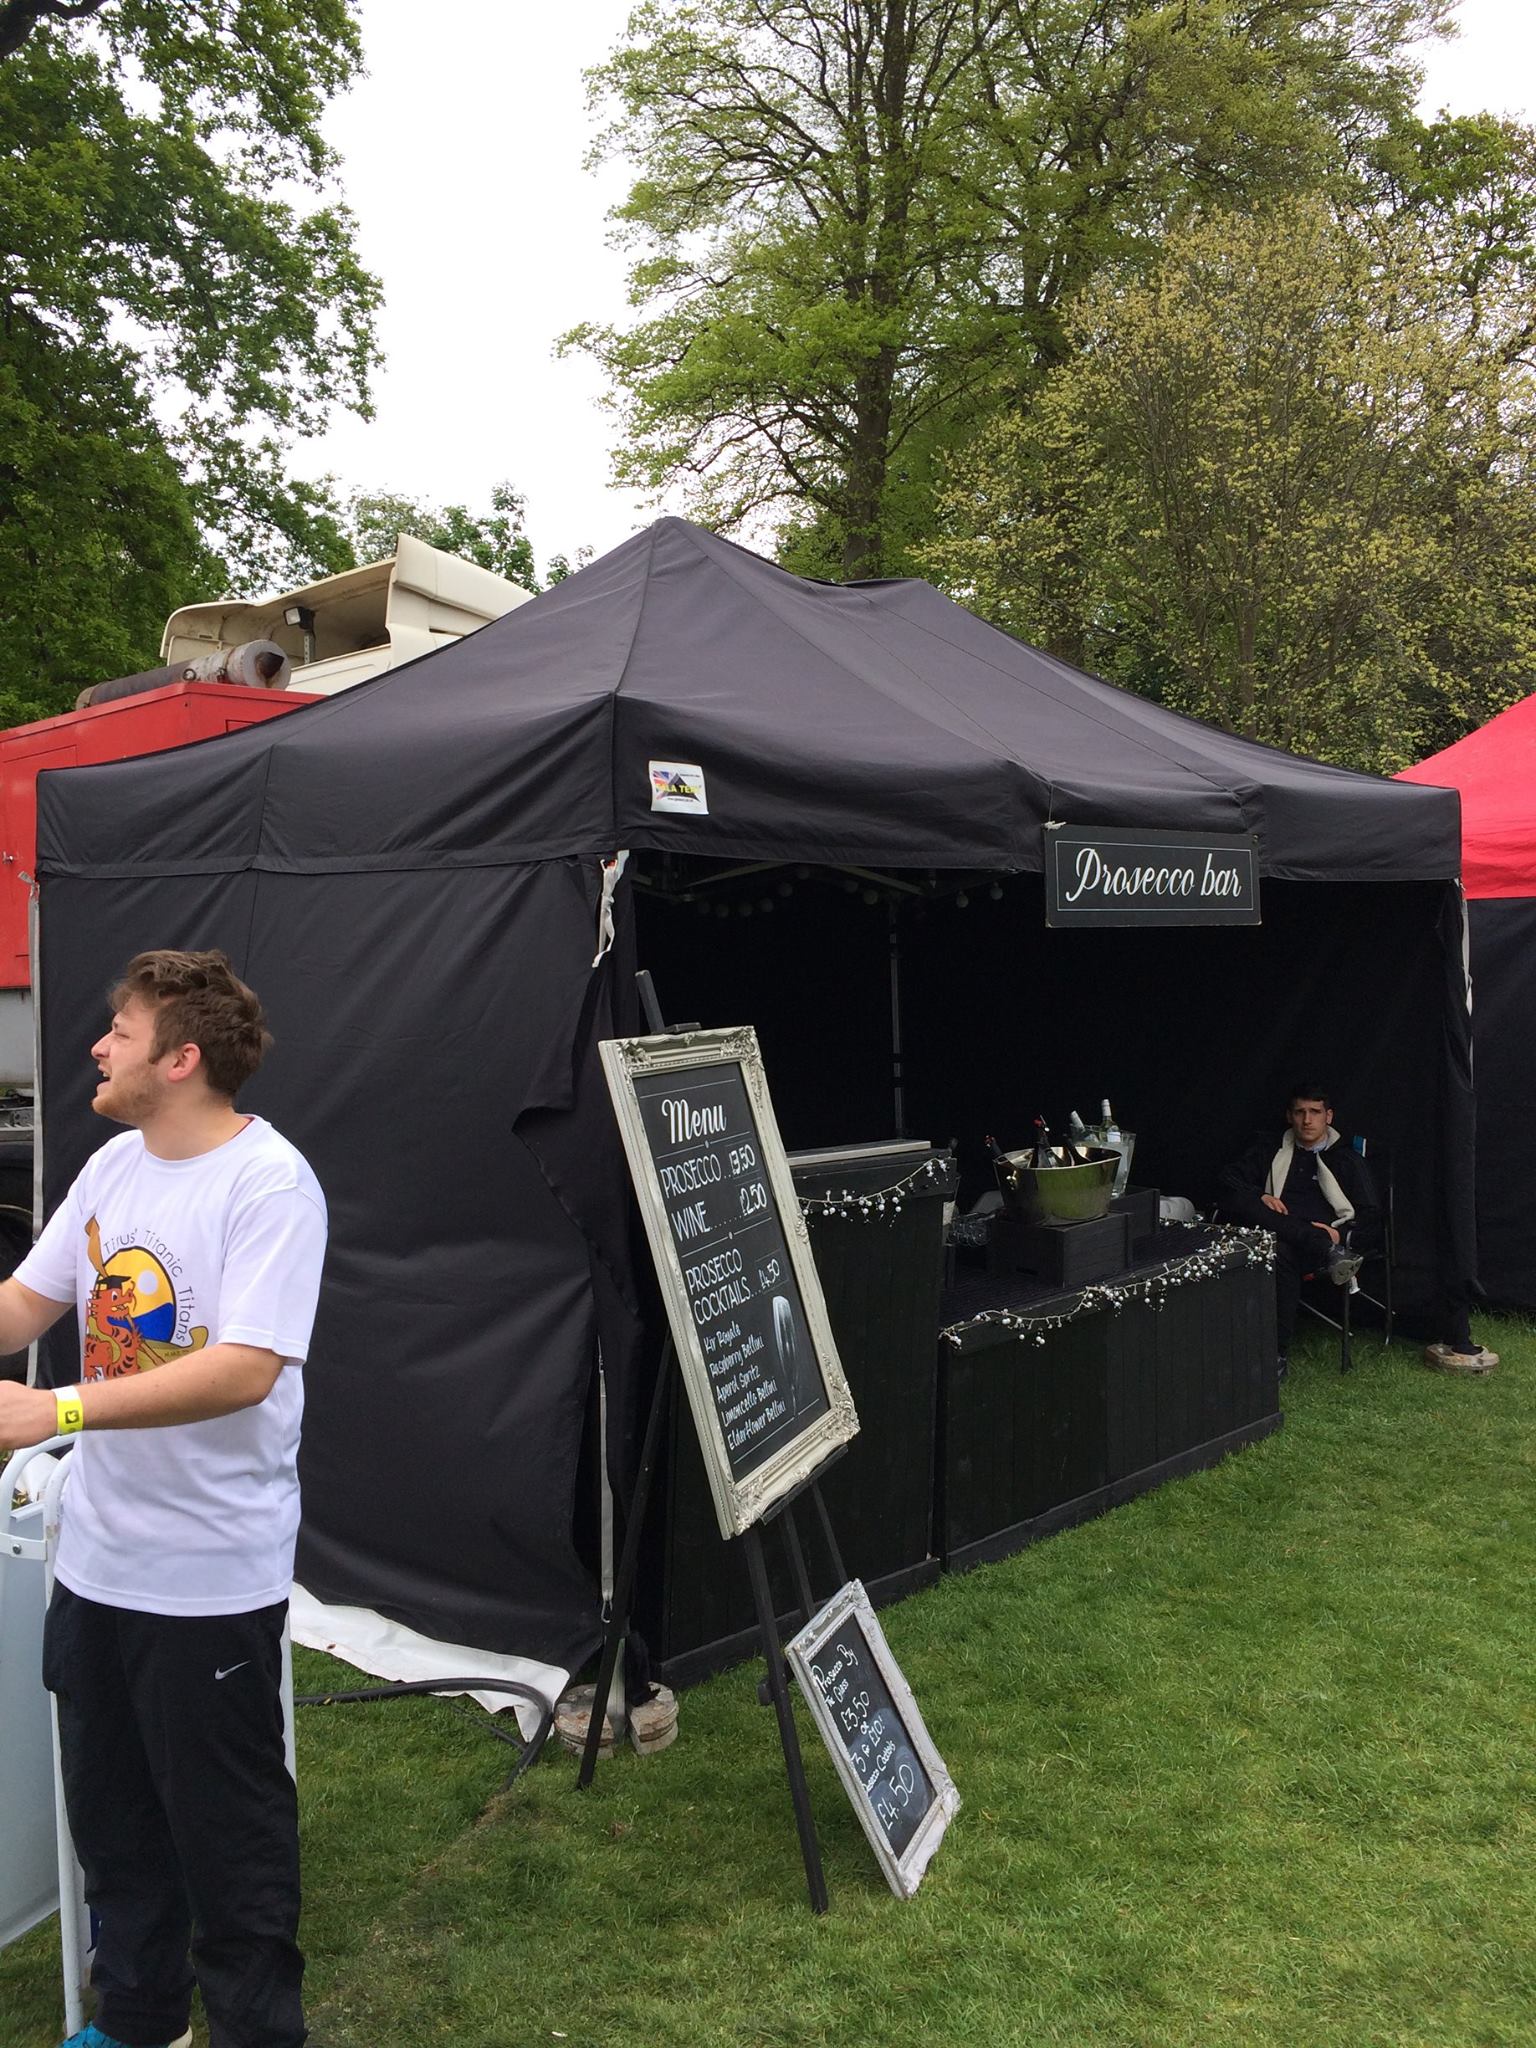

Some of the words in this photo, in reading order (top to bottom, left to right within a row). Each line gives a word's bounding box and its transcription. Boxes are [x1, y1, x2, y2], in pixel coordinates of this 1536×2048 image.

[1065, 848, 1195, 902] Prosecco
[1200, 852, 1242, 897] bar
[661, 1099, 727, 1144] Menu
[660, 1153, 722, 1199] PROSECCO
[671, 1201, 711, 1242] WINE
[143, 1229, 183, 1278] Titanic
[176, 1286, 196, 1342] Titans
[685, 1248, 743, 1295] PROSECCO
[694, 1276, 751, 1325] COCKTAILS
[703, 1336, 717, 1355] Kir
[716, 1374, 740, 1404] Aperol
[836, 1644, 859, 1667] By
[840, 1691, 870, 1732] £3.50
[851, 1752, 866, 1773] 3
[877, 1764, 914, 1831] £4.50
